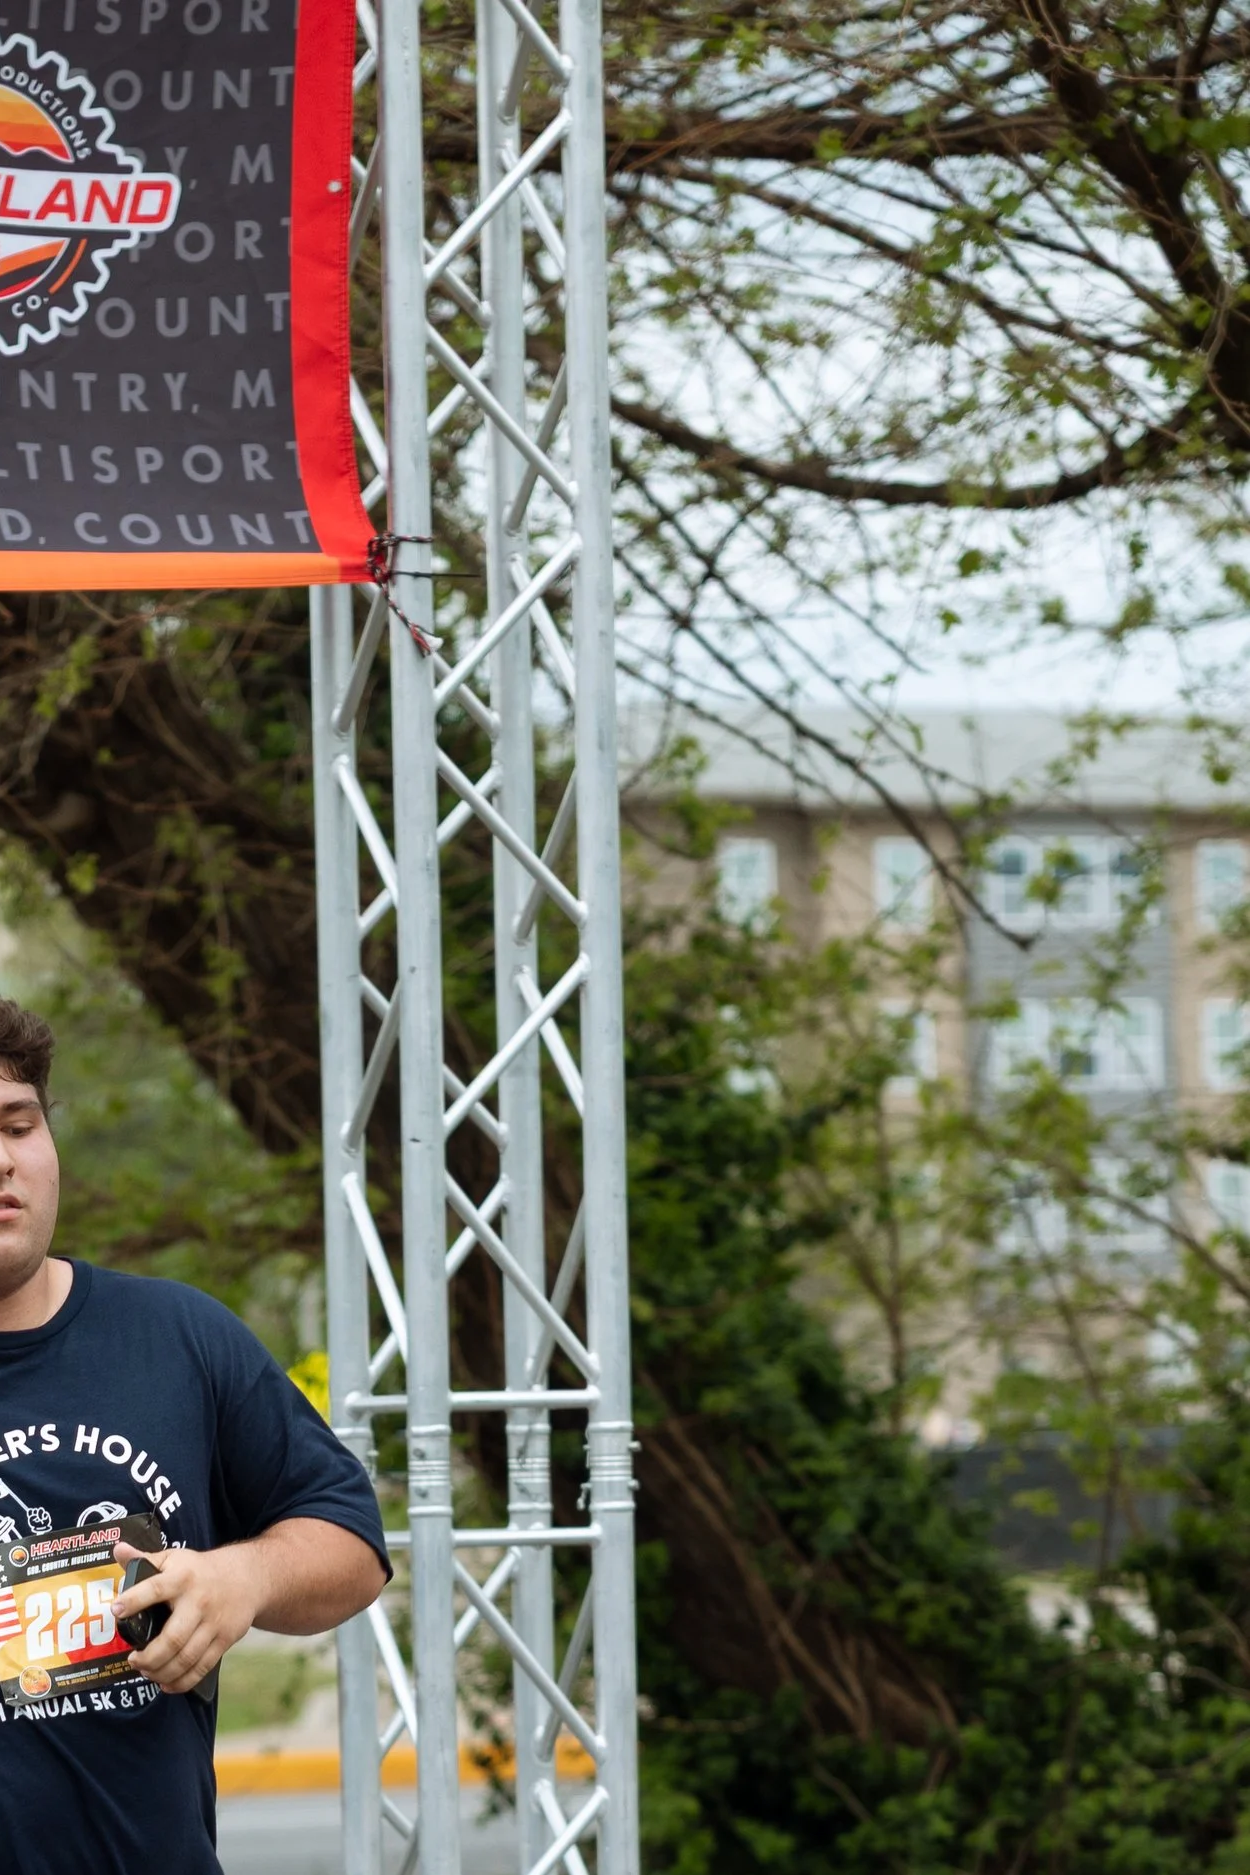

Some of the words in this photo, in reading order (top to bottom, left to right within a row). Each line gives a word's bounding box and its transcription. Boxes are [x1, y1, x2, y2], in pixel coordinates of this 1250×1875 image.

[73, 1424, 182, 1520] HOUSE
[30, 1527, 121, 1557] HEARTLAND
[90, 1690, 116, 1711] 5K
[120, 1689, 134, 1708] &
